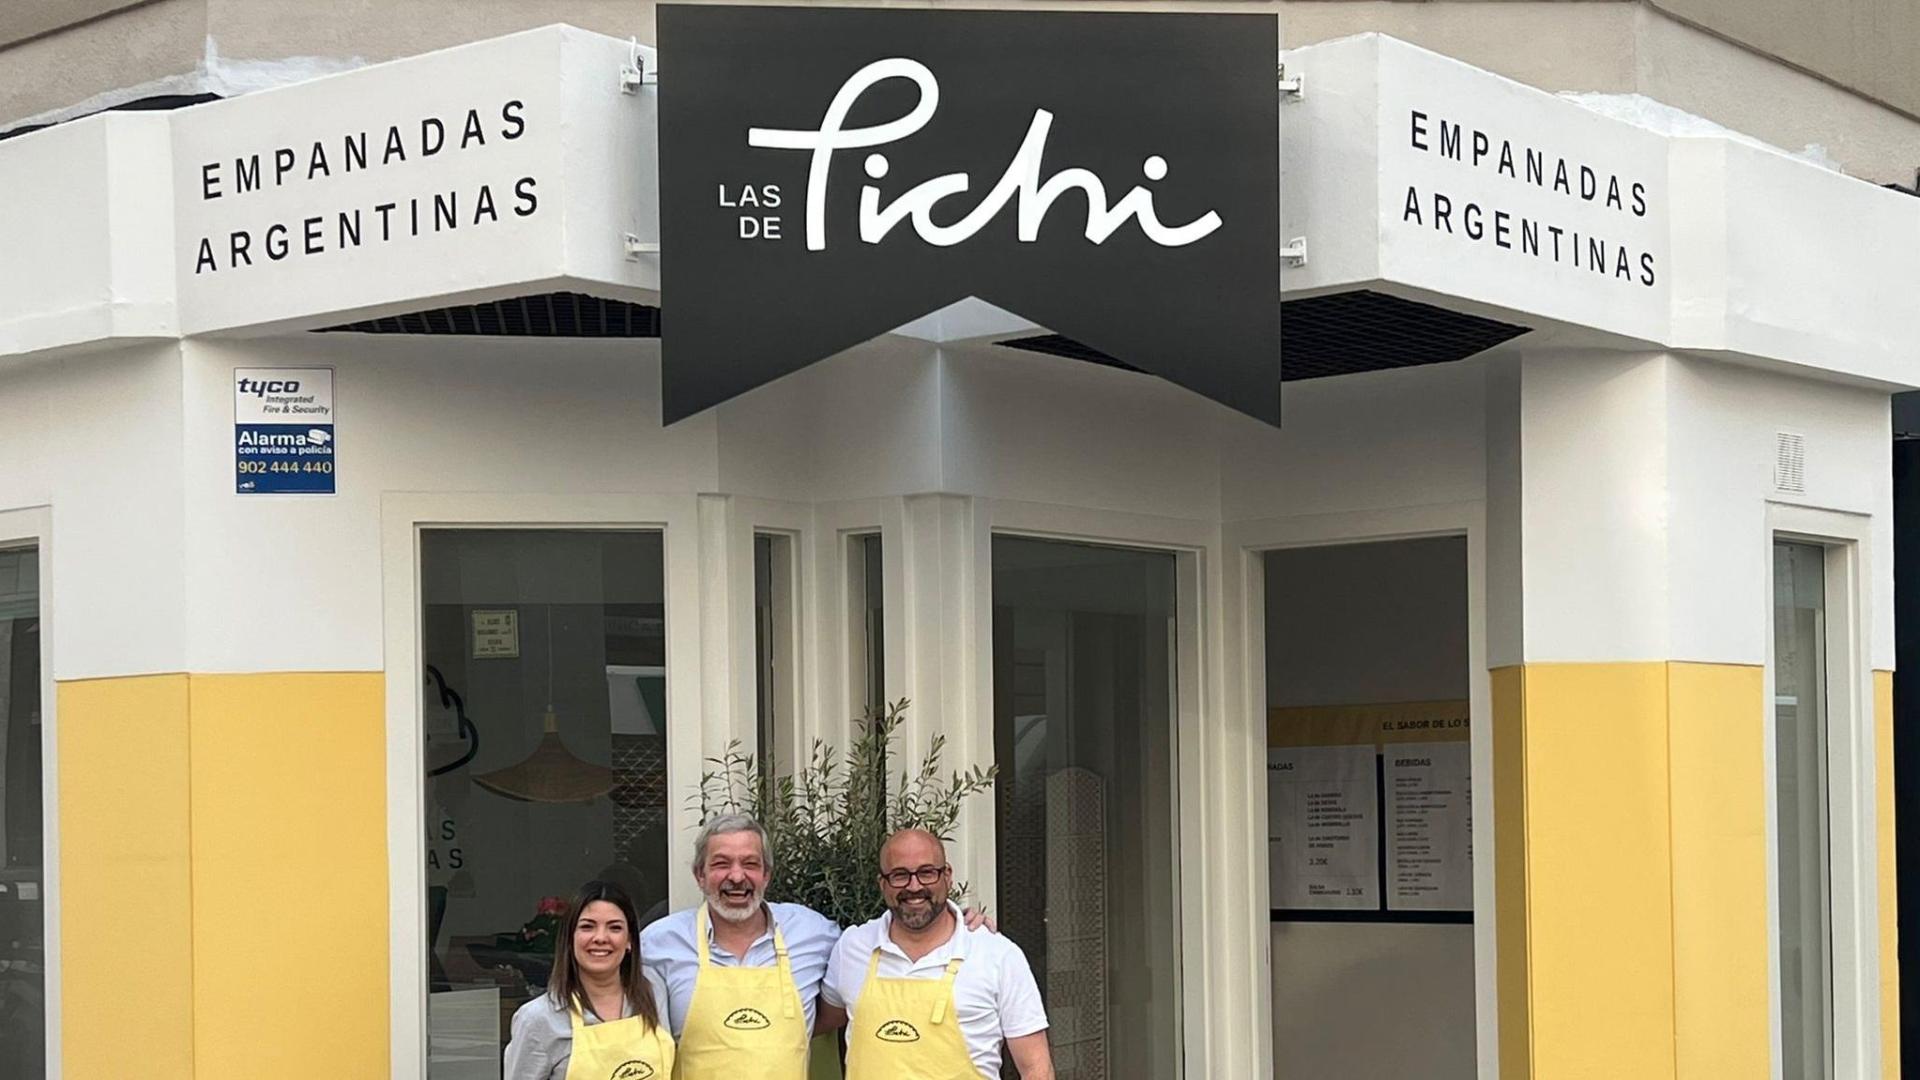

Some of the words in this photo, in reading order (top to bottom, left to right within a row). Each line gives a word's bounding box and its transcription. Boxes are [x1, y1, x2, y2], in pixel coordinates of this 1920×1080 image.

[202, 99, 525, 200] EMPANADAS
[748, 57, 1223, 251] Pichi
[1411, 110, 1646, 217] EMPANADAS
[718, 184, 782, 208] LAS
[195, 176, 538, 274] ARGENTINAS
[739, 216, 782, 240] DE
[1403, 186, 1655, 287] ARGENTINAS
[237, 378, 300, 398] tyco
[262, 405, 280, 413] Fire
[282, 405, 290, 413] &
[291, 405, 330, 415] Security
[265, 395, 315, 405] Integrated
[238, 431, 306, 445] Alarma
[260, 446, 288, 454] aviso
[238, 461, 267, 473] 902
[270, 461, 299, 473] 444
[303, 461, 333, 473] 440
[1382, 721, 1394, 730] EL
[1397, 720, 1430, 730] SABOR
[1432, 719, 1445, 729] DE
[1448, 719, 1461, 728] LO
